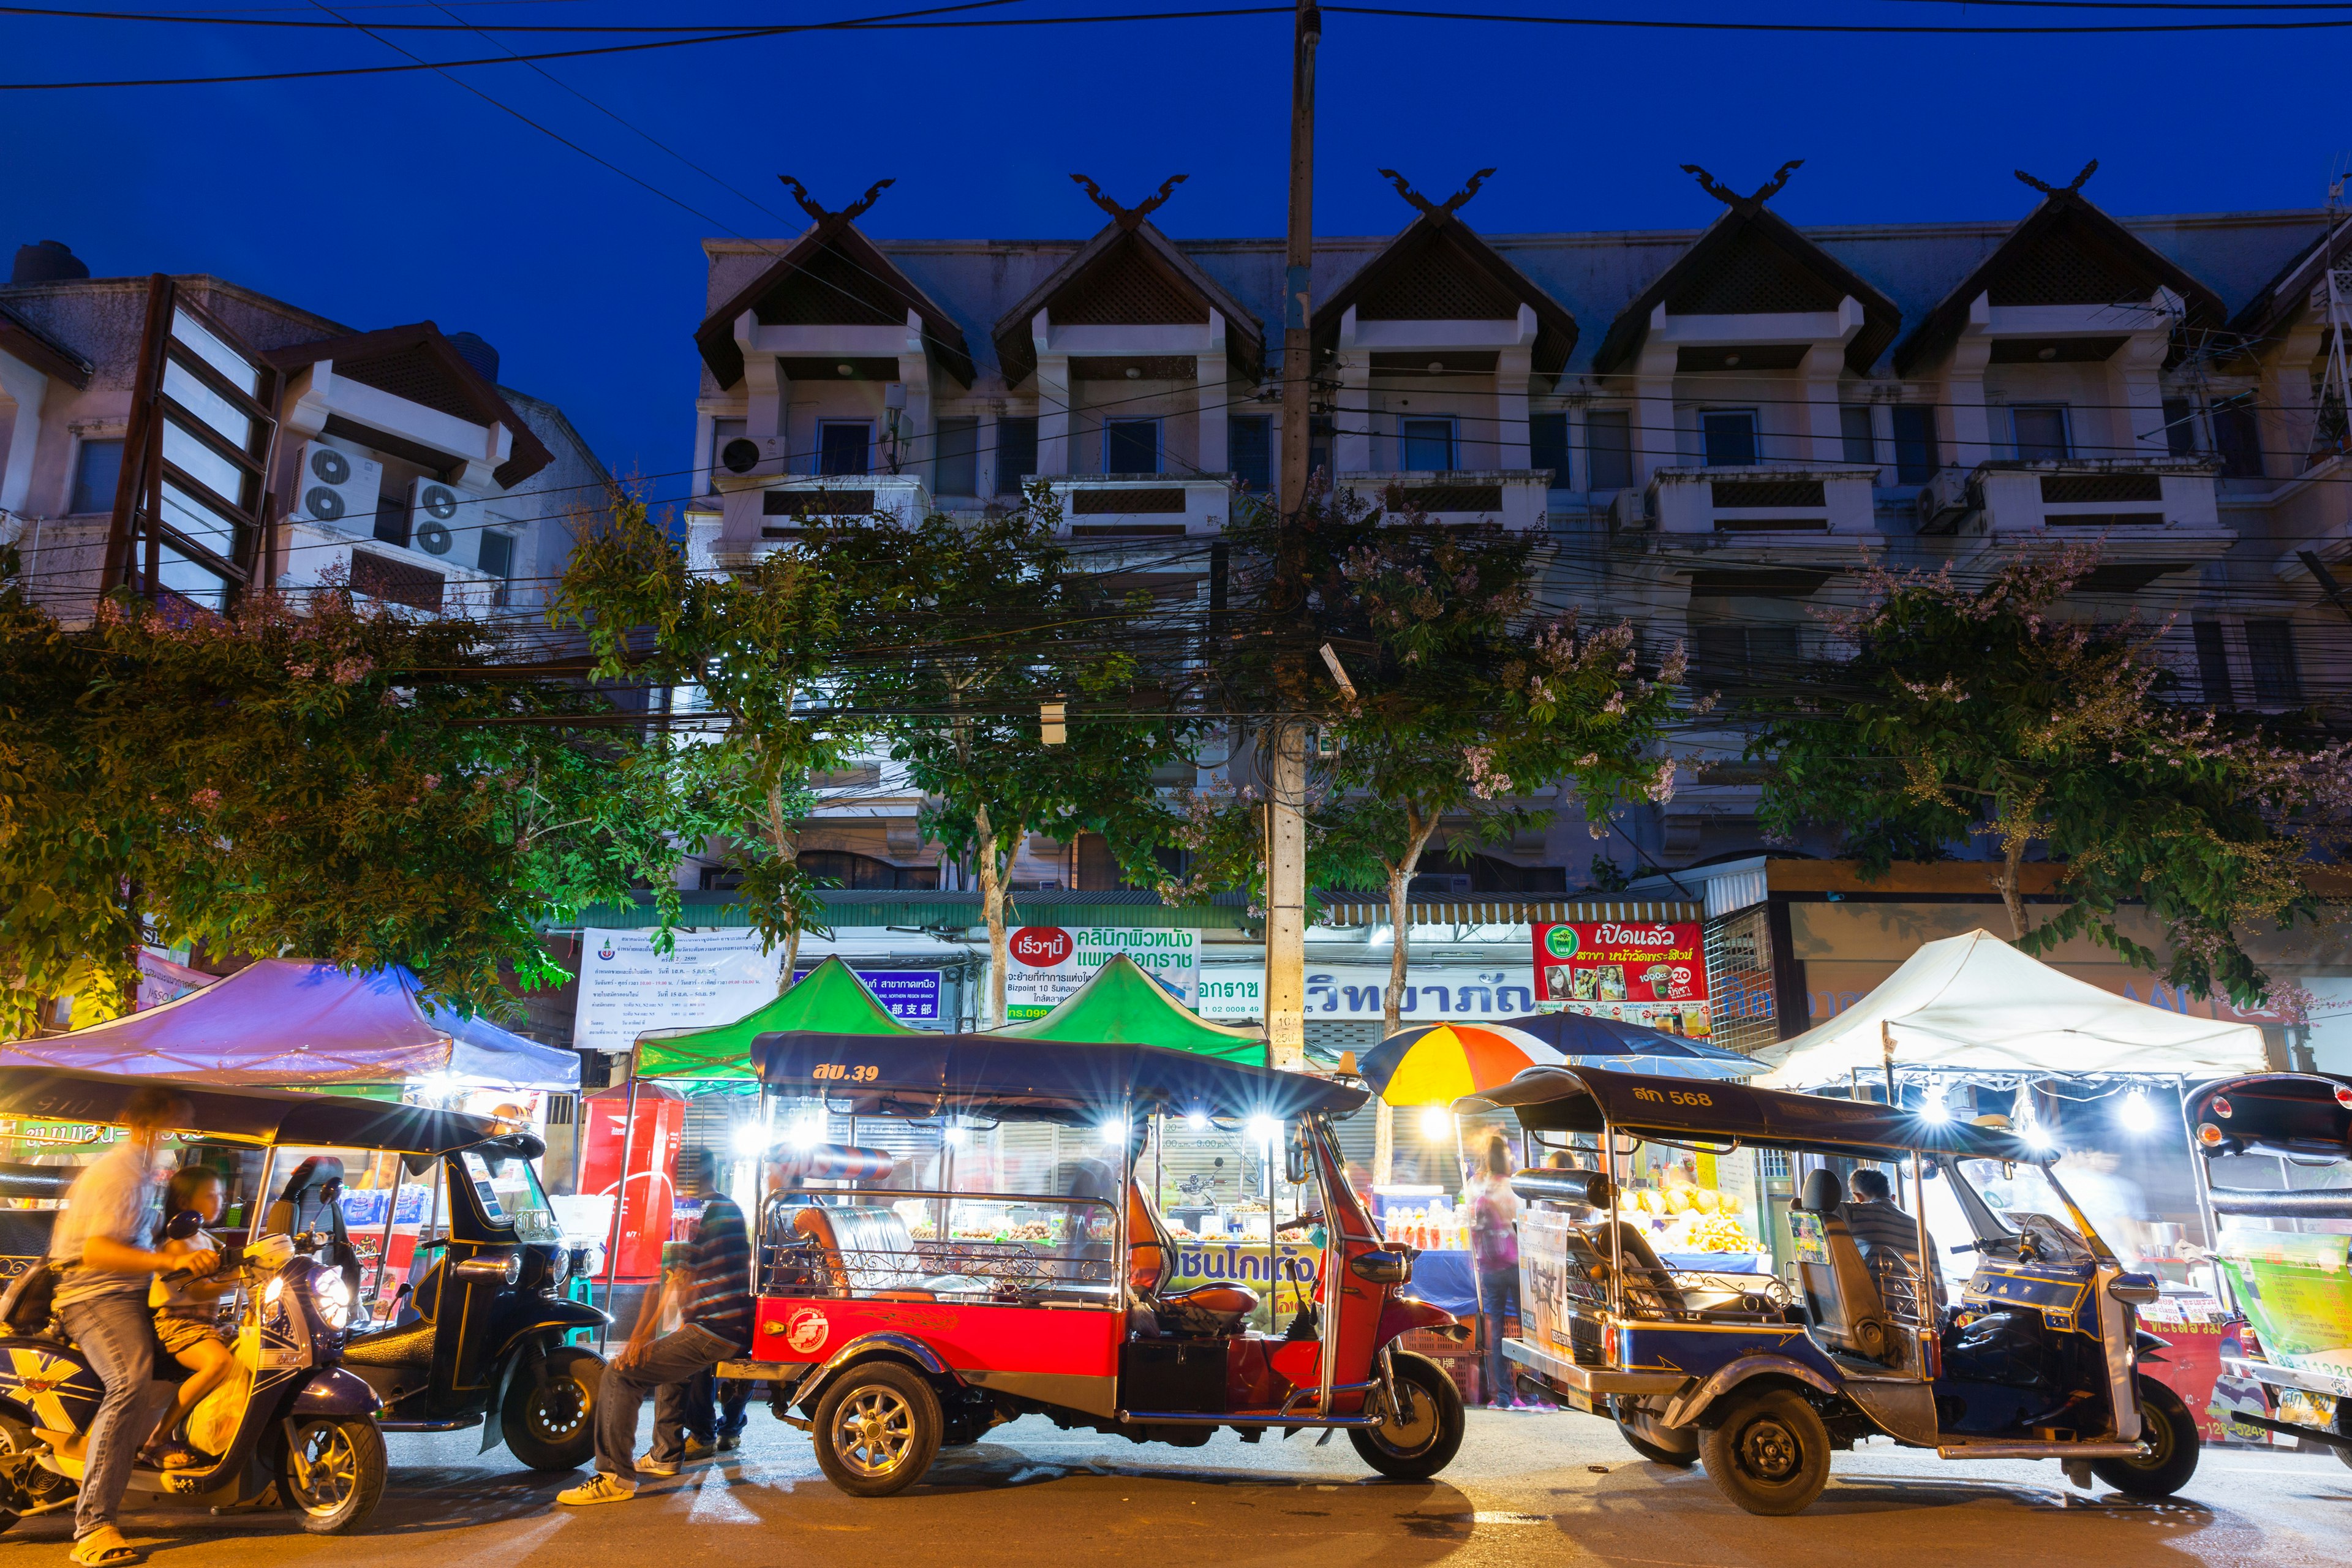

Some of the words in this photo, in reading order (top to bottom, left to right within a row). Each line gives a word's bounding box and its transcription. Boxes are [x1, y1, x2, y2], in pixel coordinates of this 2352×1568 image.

[1077, 928, 1193, 947] คลินิกผิวหนัง
[1595, 923, 1675, 946] เปิดแล้ว
[1017, 934, 1063, 958] เร็วๆนี้
[1577, 951, 1605, 961] สาขา
[1608, 948, 1694, 962] หน้าวัดพระสิงห์
[1639, 971, 1667, 982] 1000cc
[1673, 971, 1690, 981] 20
[1008, 984, 1036, 993] Bizpoint
[884, 1003, 932, 1015] 部支部
[1278, 1017, 1291, 1027] 10
[1275, 1033, 1294, 1043] 250
[1668, 1091, 1713, 1107] 568
[1778, 1102, 1819, 1117] TIGER
[533, 1212, 549, 1228] 910
[2158, 1305, 2178, 1314] clams
[2187, 1306, 2220, 1314] Seafood
[2207, 1313, 2230, 1324] 50
